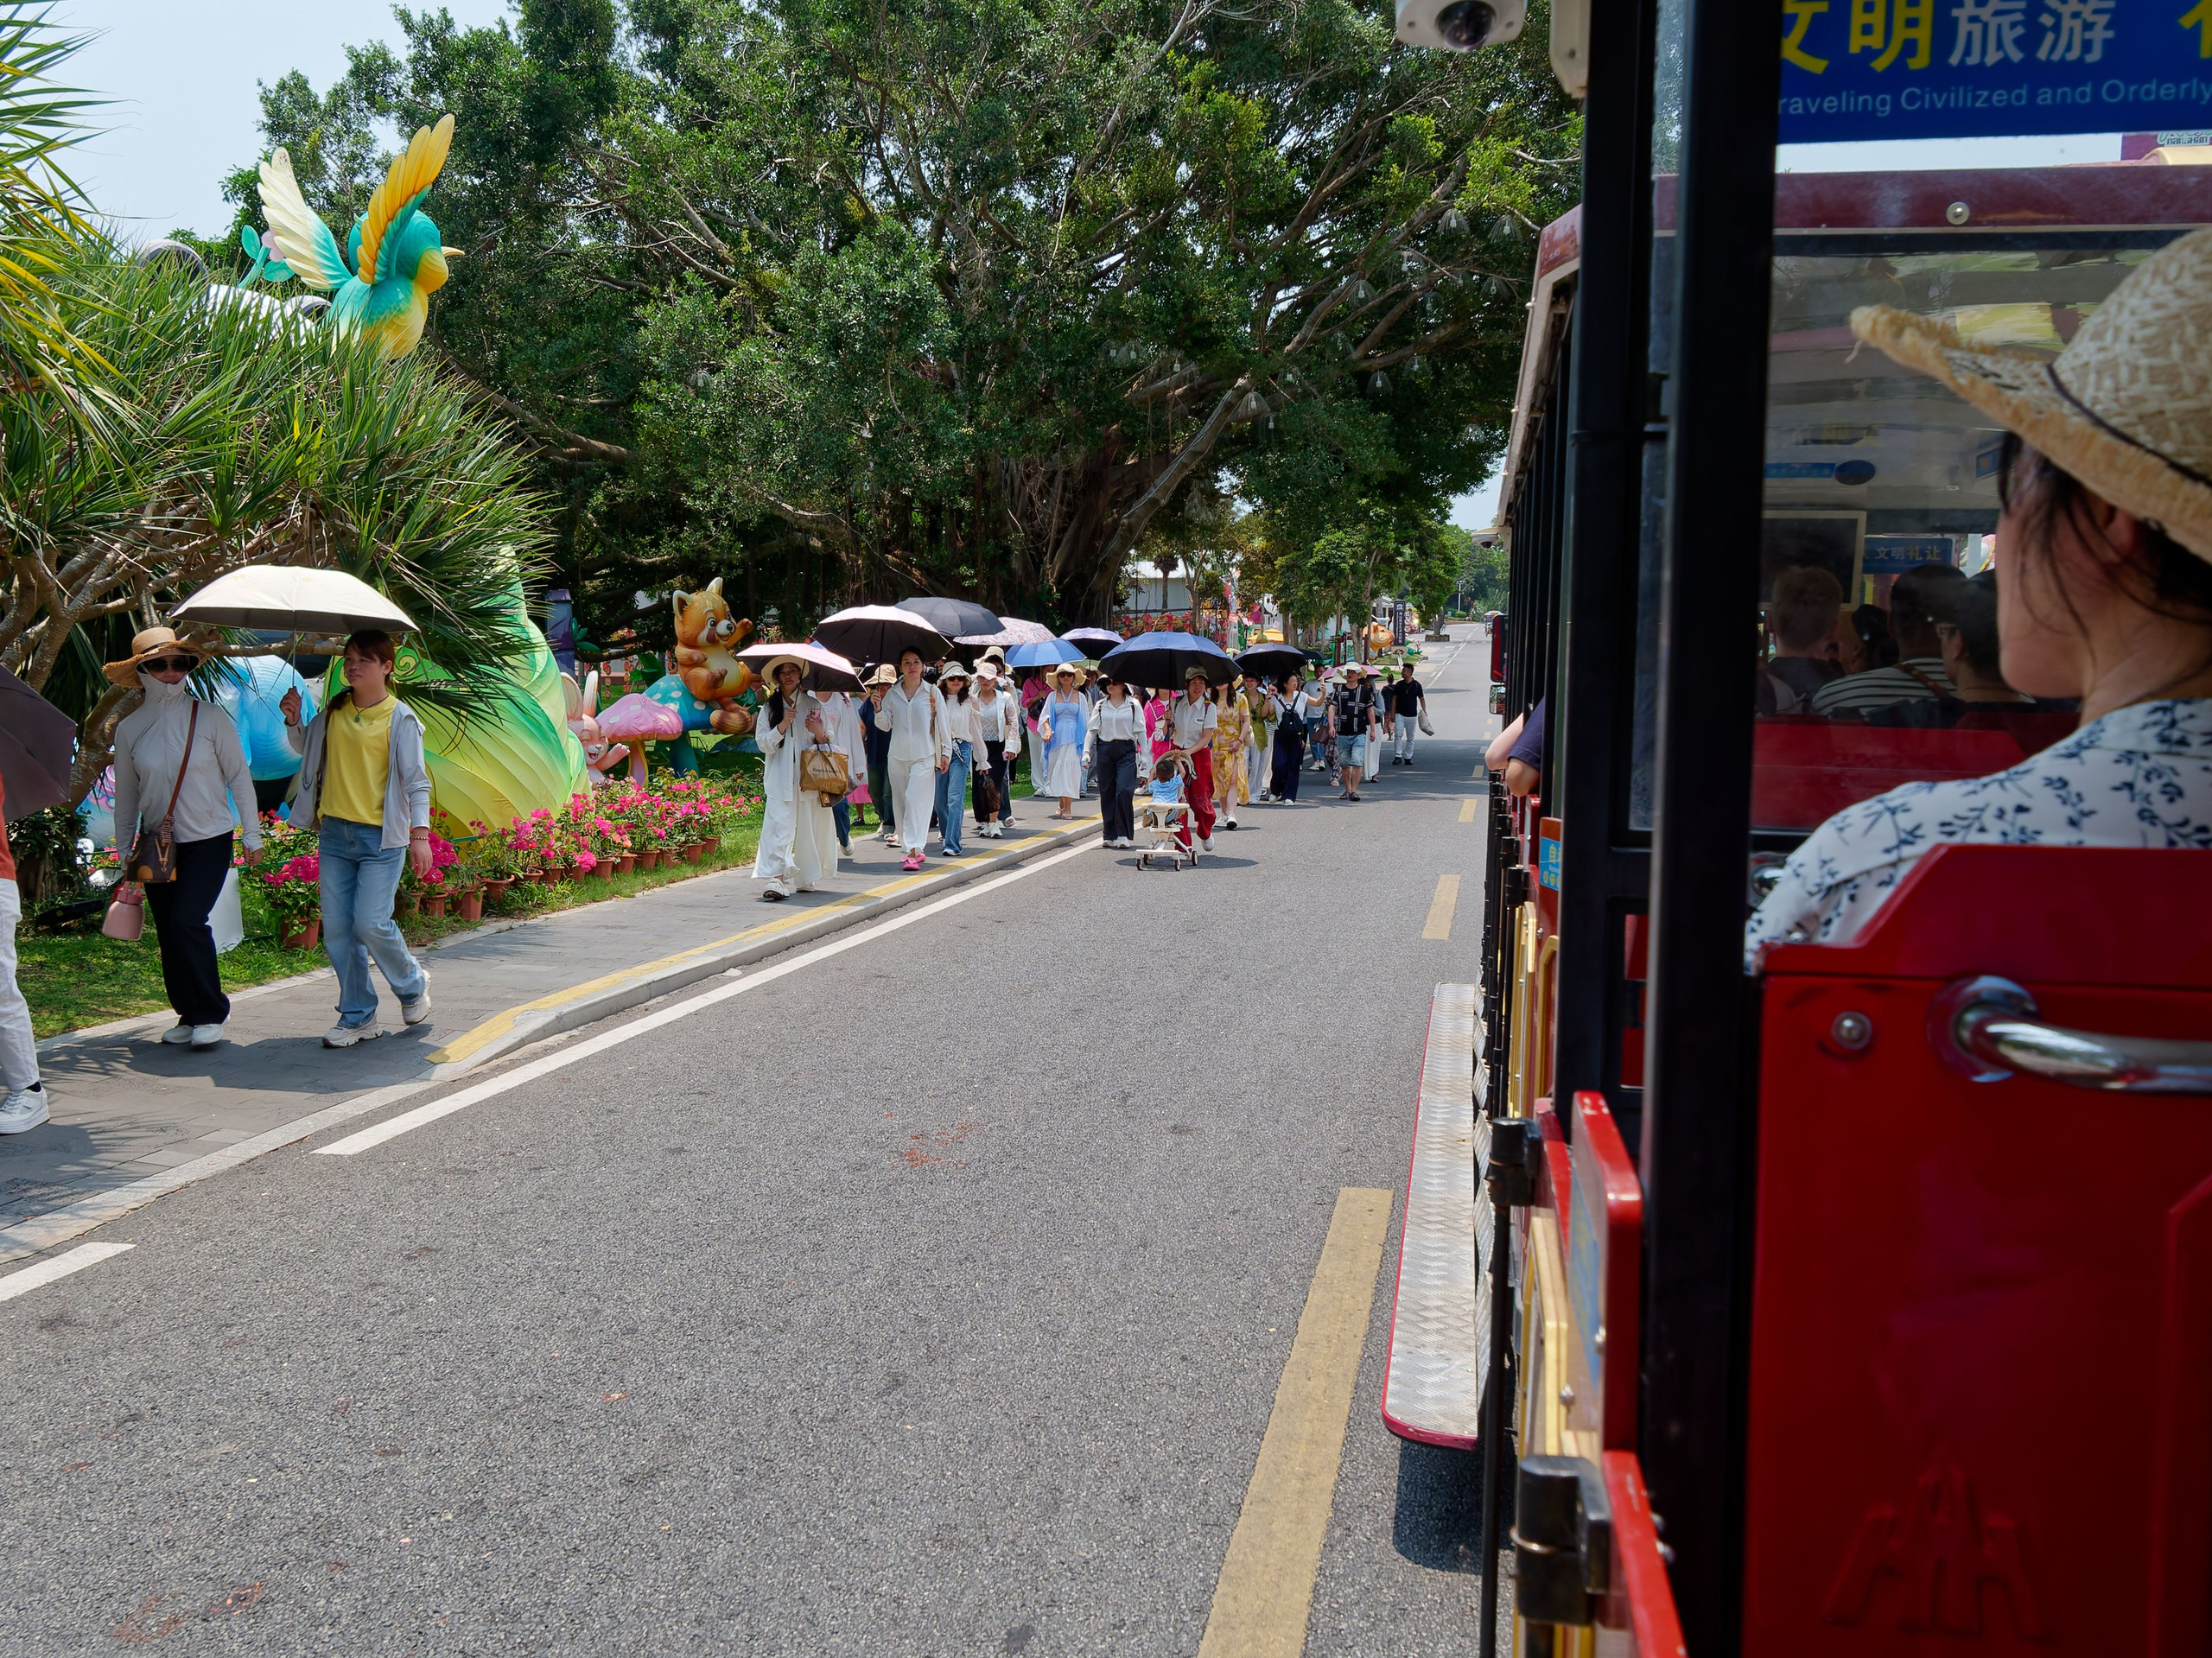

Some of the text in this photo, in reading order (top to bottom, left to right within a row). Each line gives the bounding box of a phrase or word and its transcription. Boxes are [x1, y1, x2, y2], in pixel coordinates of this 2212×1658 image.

[1777, 77, 2212, 118] raveling Civilized and Orderly
[1875, 545, 1941, 561] 文明礼让
